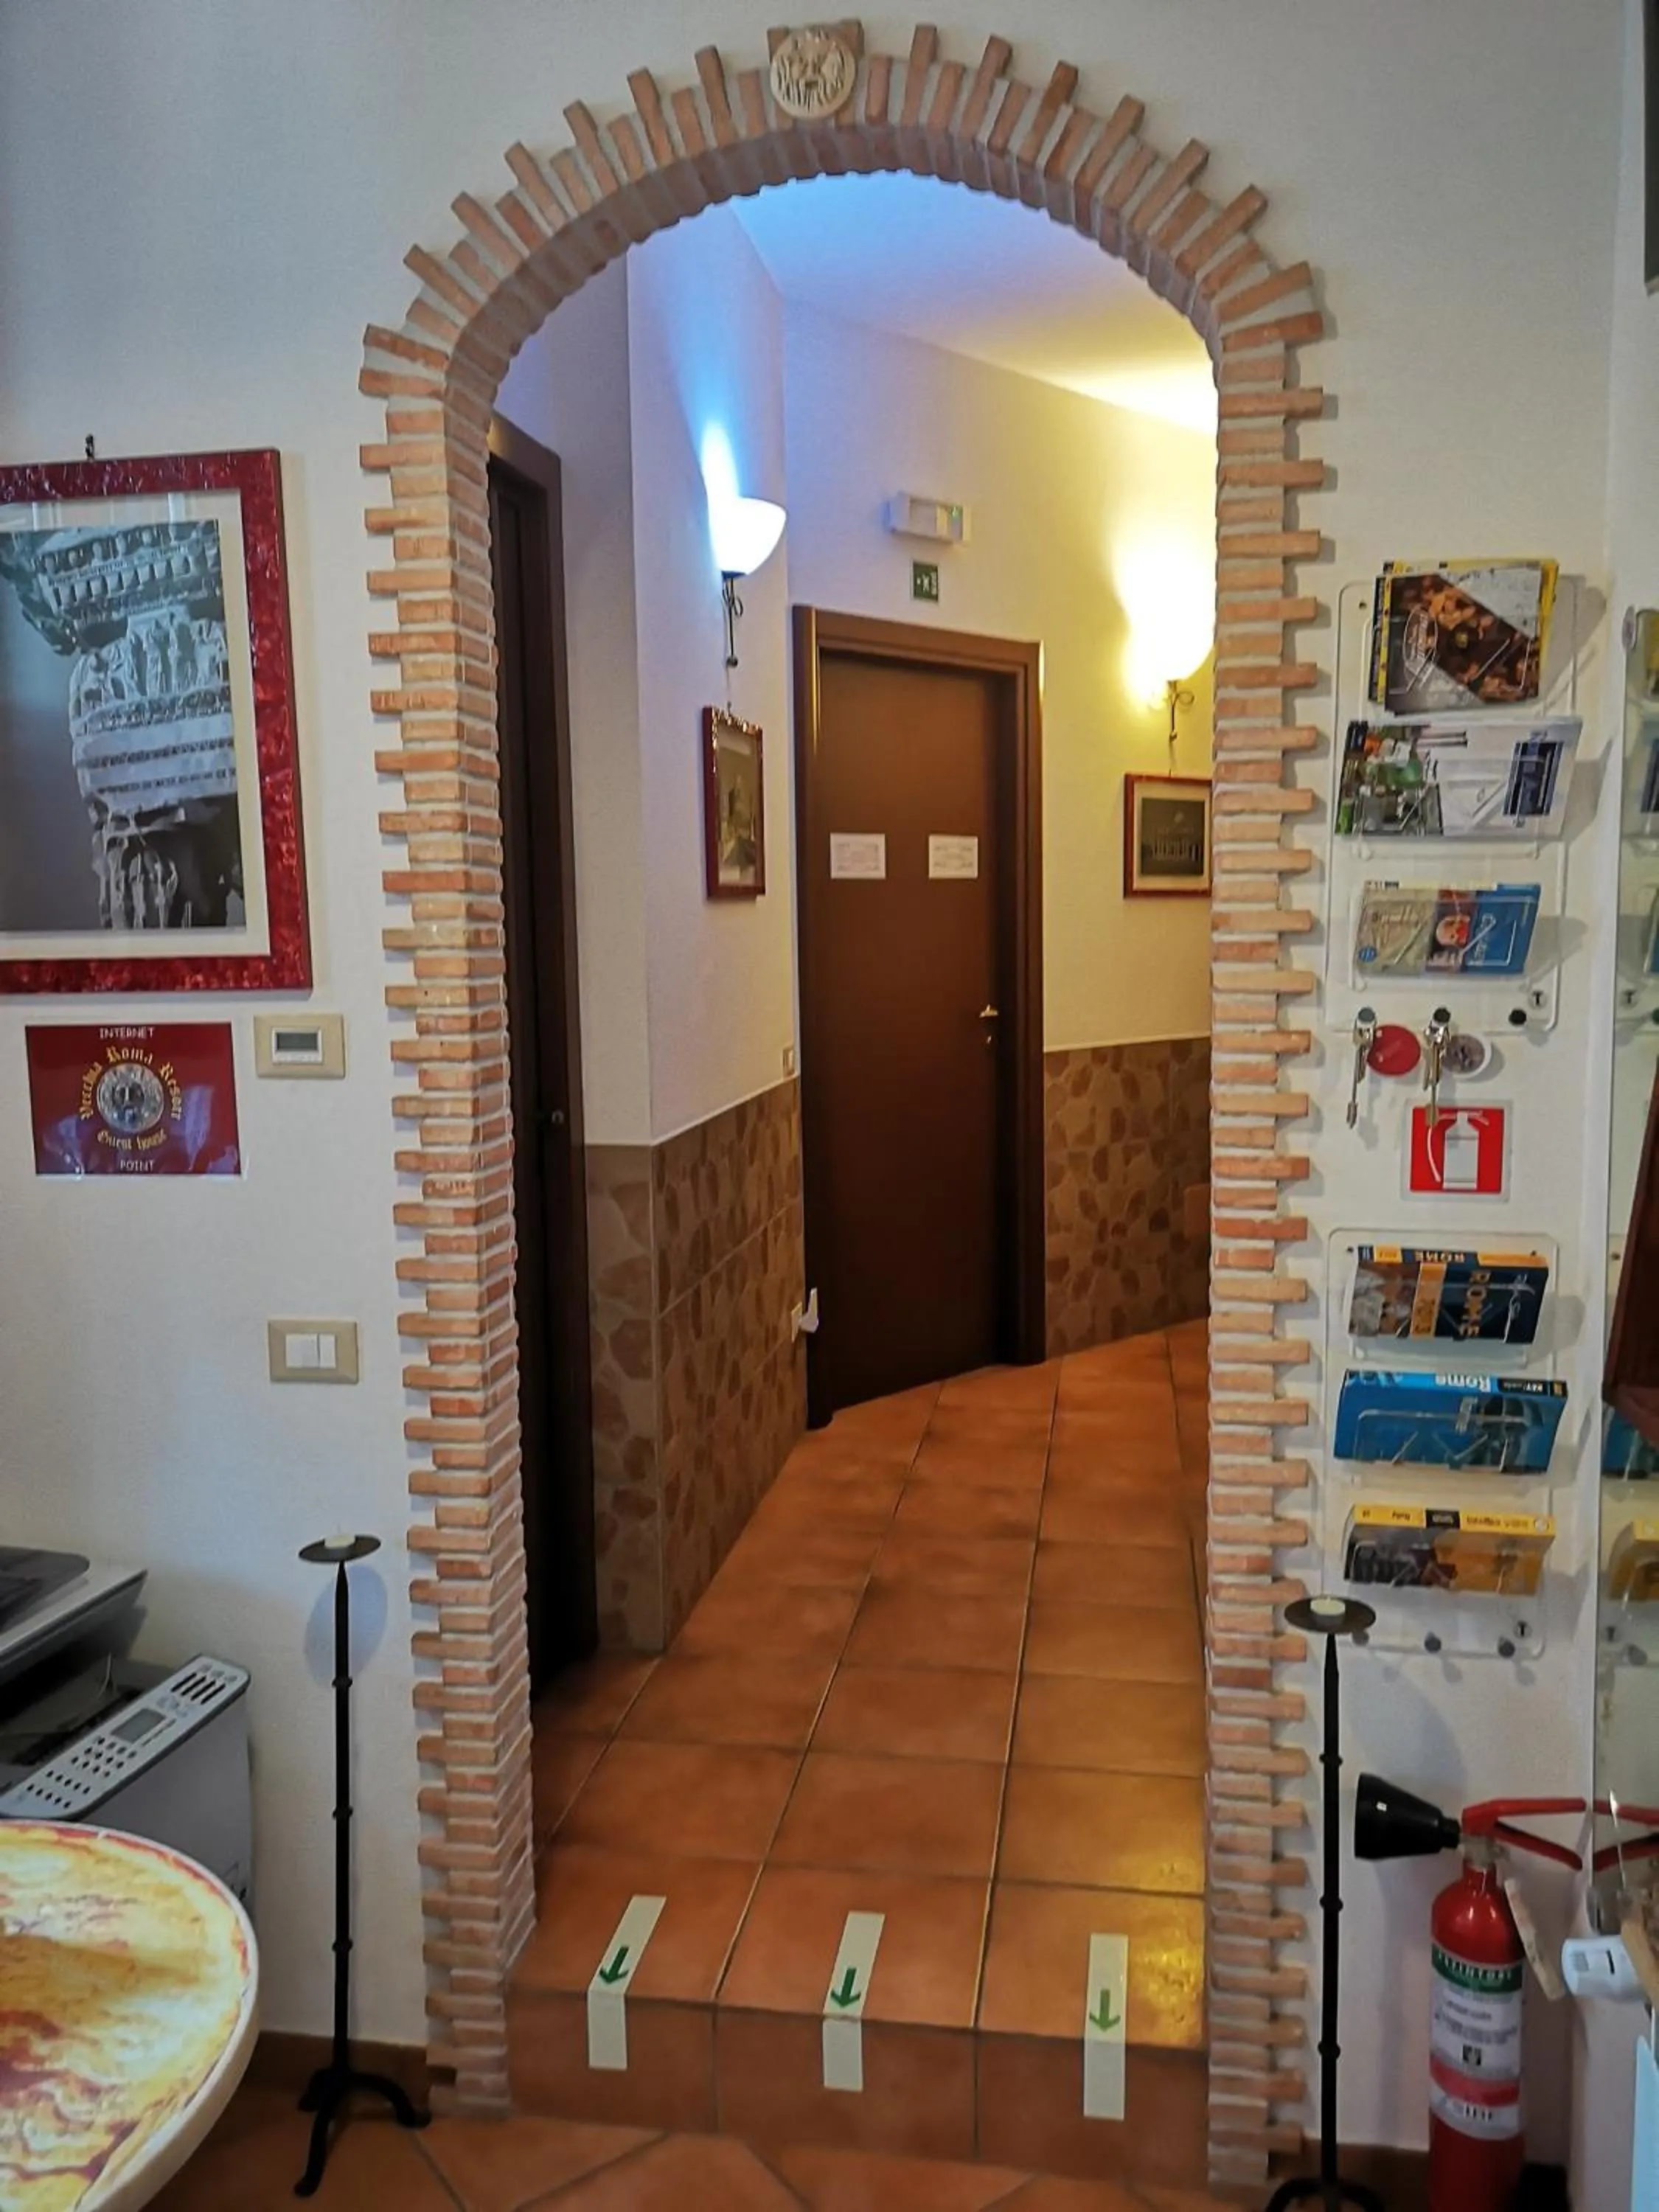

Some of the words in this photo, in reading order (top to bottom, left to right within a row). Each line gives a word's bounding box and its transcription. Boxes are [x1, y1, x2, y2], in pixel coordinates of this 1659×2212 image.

[99, 1026, 155, 1040] INTERNET
[105, 1046, 154, 1065] Roma
[119, 1159, 155, 1172] POINT
[1458, 1269, 1492, 1338] ROME
[1433, 1373, 1492, 1393] Rome
